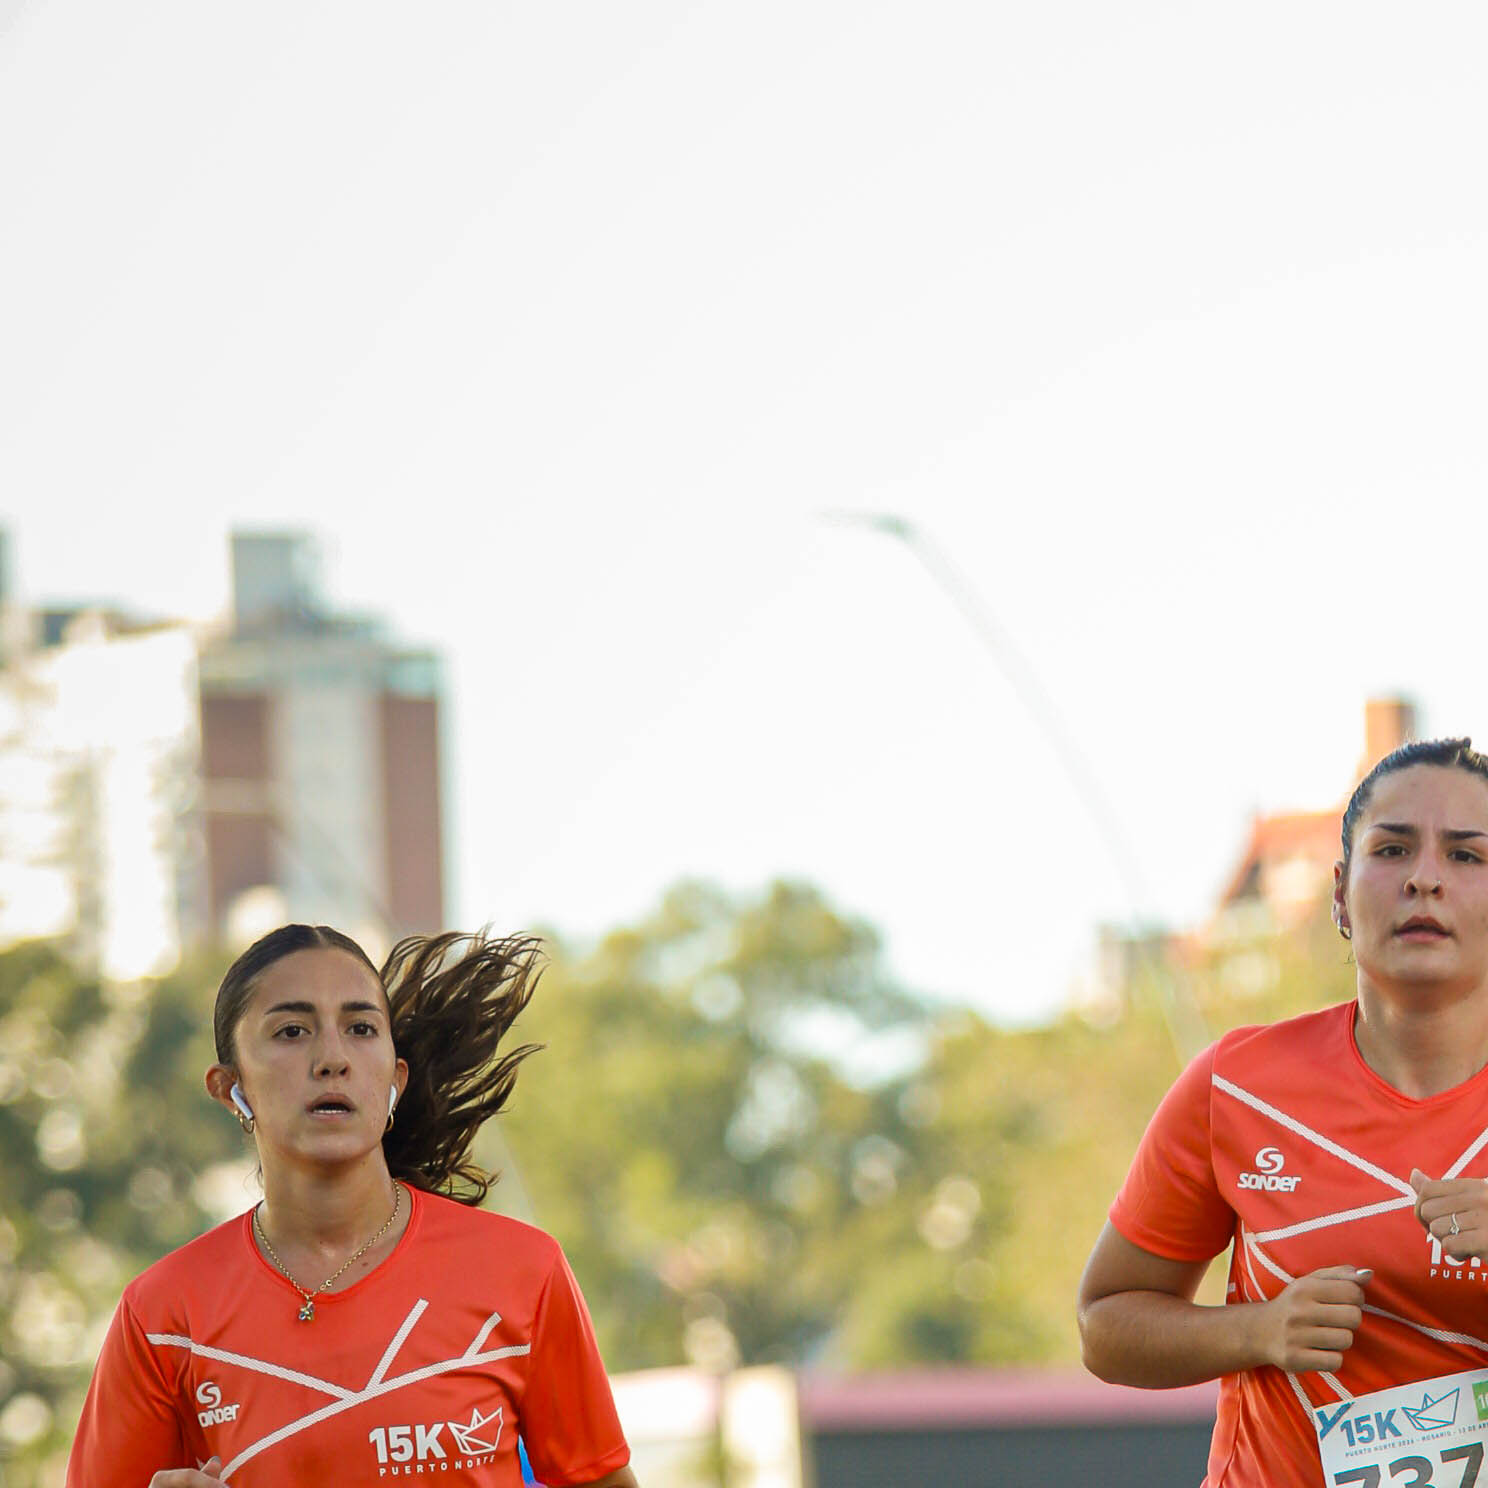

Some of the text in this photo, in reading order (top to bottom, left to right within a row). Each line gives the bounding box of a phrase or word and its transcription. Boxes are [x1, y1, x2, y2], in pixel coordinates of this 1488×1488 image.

[368, 1423, 447, 1464] 15K
[1340, 1408, 1402, 1447] 15K
[378, 1462, 448, 1477] PUERTO
